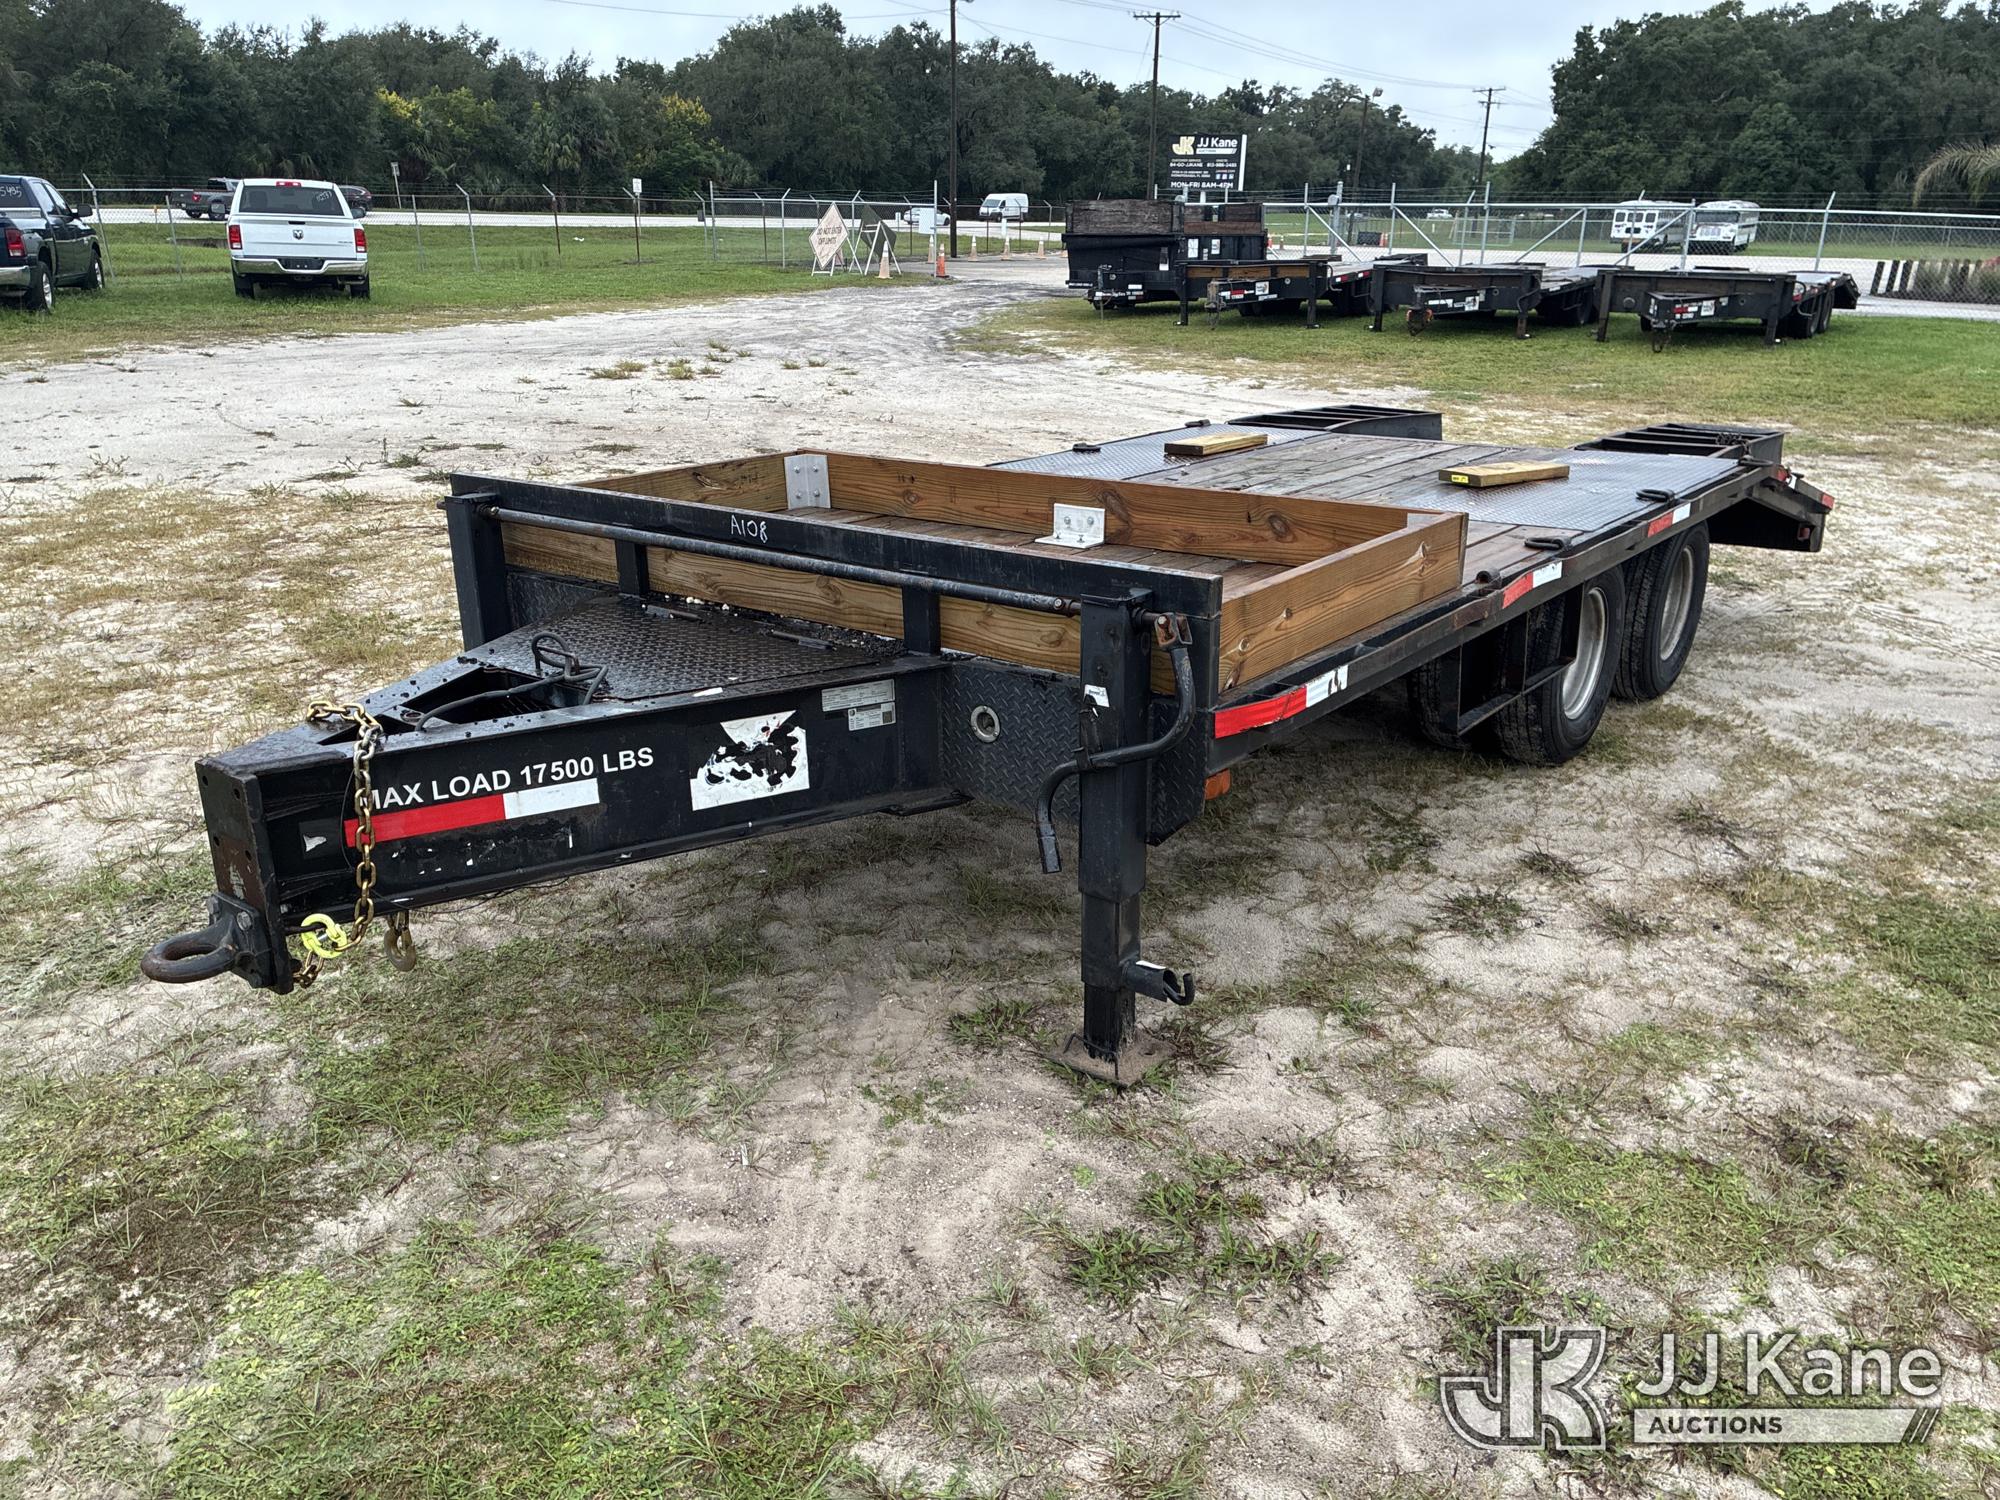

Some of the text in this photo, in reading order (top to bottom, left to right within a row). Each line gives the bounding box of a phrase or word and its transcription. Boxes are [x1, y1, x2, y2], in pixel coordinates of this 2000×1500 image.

[1197, 137, 1238, 148] JJ Kane
[731, 514, 768, 544] A108
[360, 747, 654, 810] MAX LOAD 17500 LBS
